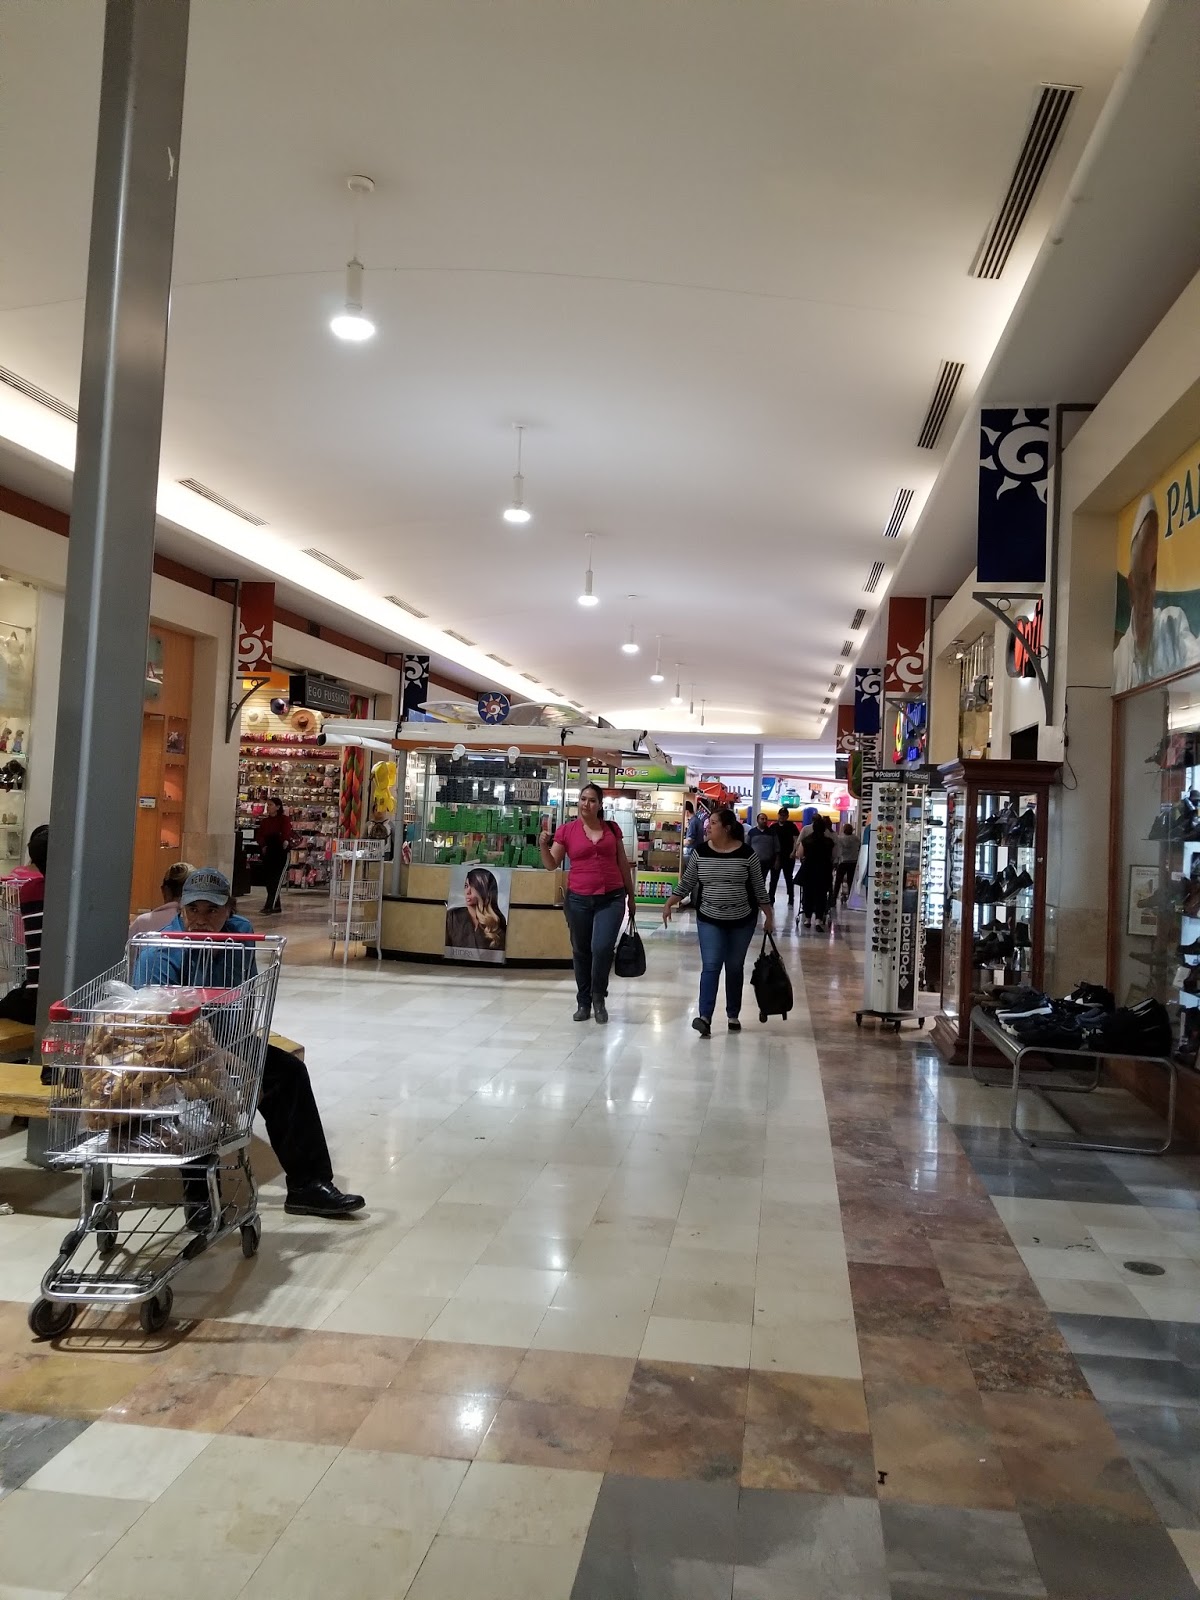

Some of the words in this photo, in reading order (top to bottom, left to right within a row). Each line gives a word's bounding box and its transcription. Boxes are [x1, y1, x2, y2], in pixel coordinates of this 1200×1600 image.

[1165, 462, 1200, 538] PA
[308, 685, 321, 698] EGO
[909, 772, 929, 780] Polaroid
[191, 874, 204, 884] NEW
[206, 874, 221, 887] YORK
[900, 913, 911, 974] Polaroid
